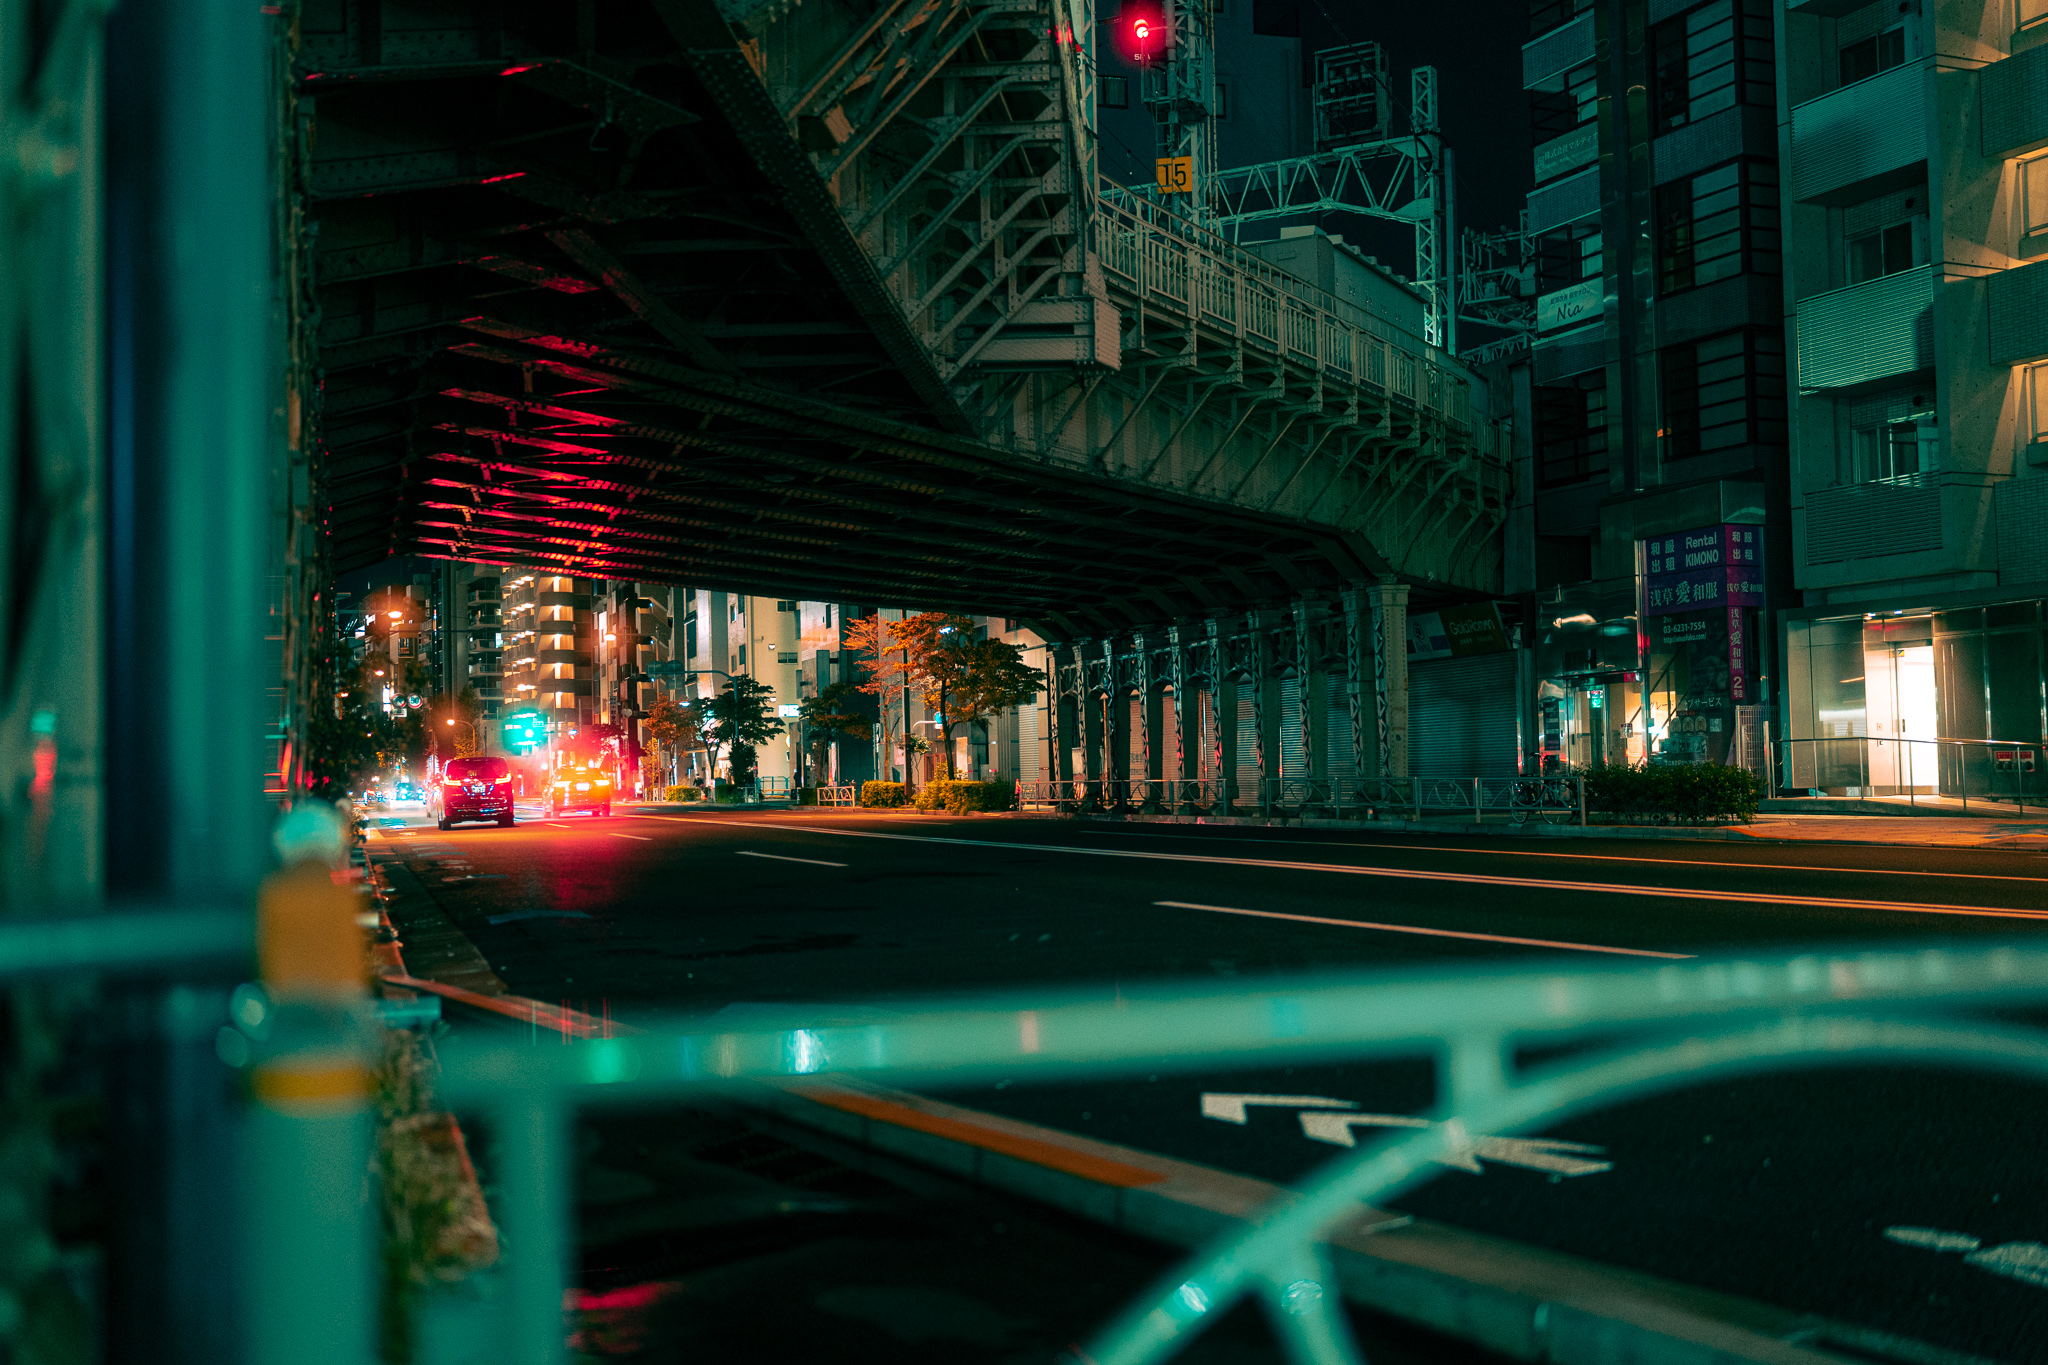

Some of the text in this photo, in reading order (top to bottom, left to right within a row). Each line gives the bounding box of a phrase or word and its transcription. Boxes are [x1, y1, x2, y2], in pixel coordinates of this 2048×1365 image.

[1163, 163, 1186, 186] 15
[1557, 302, 1584, 322] Nia
[1685, 532, 1717, 549] Rental
[1732, 531, 1753, 543] 和服
[1650, 540, 1675, 556] 和服
[1733, 549, 1753, 560] 出租
[1651, 556, 1675, 573] 出租
[1685, 549, 1719, 567] KIMONO
[1650, 581, 1718, 607] 浅草愛和服
[1663, 621, 1706, 634] 03-6231-7554
[1730, 608, 1743, 669] 浅草愛和服
[410, 696, 420, 704] 50
